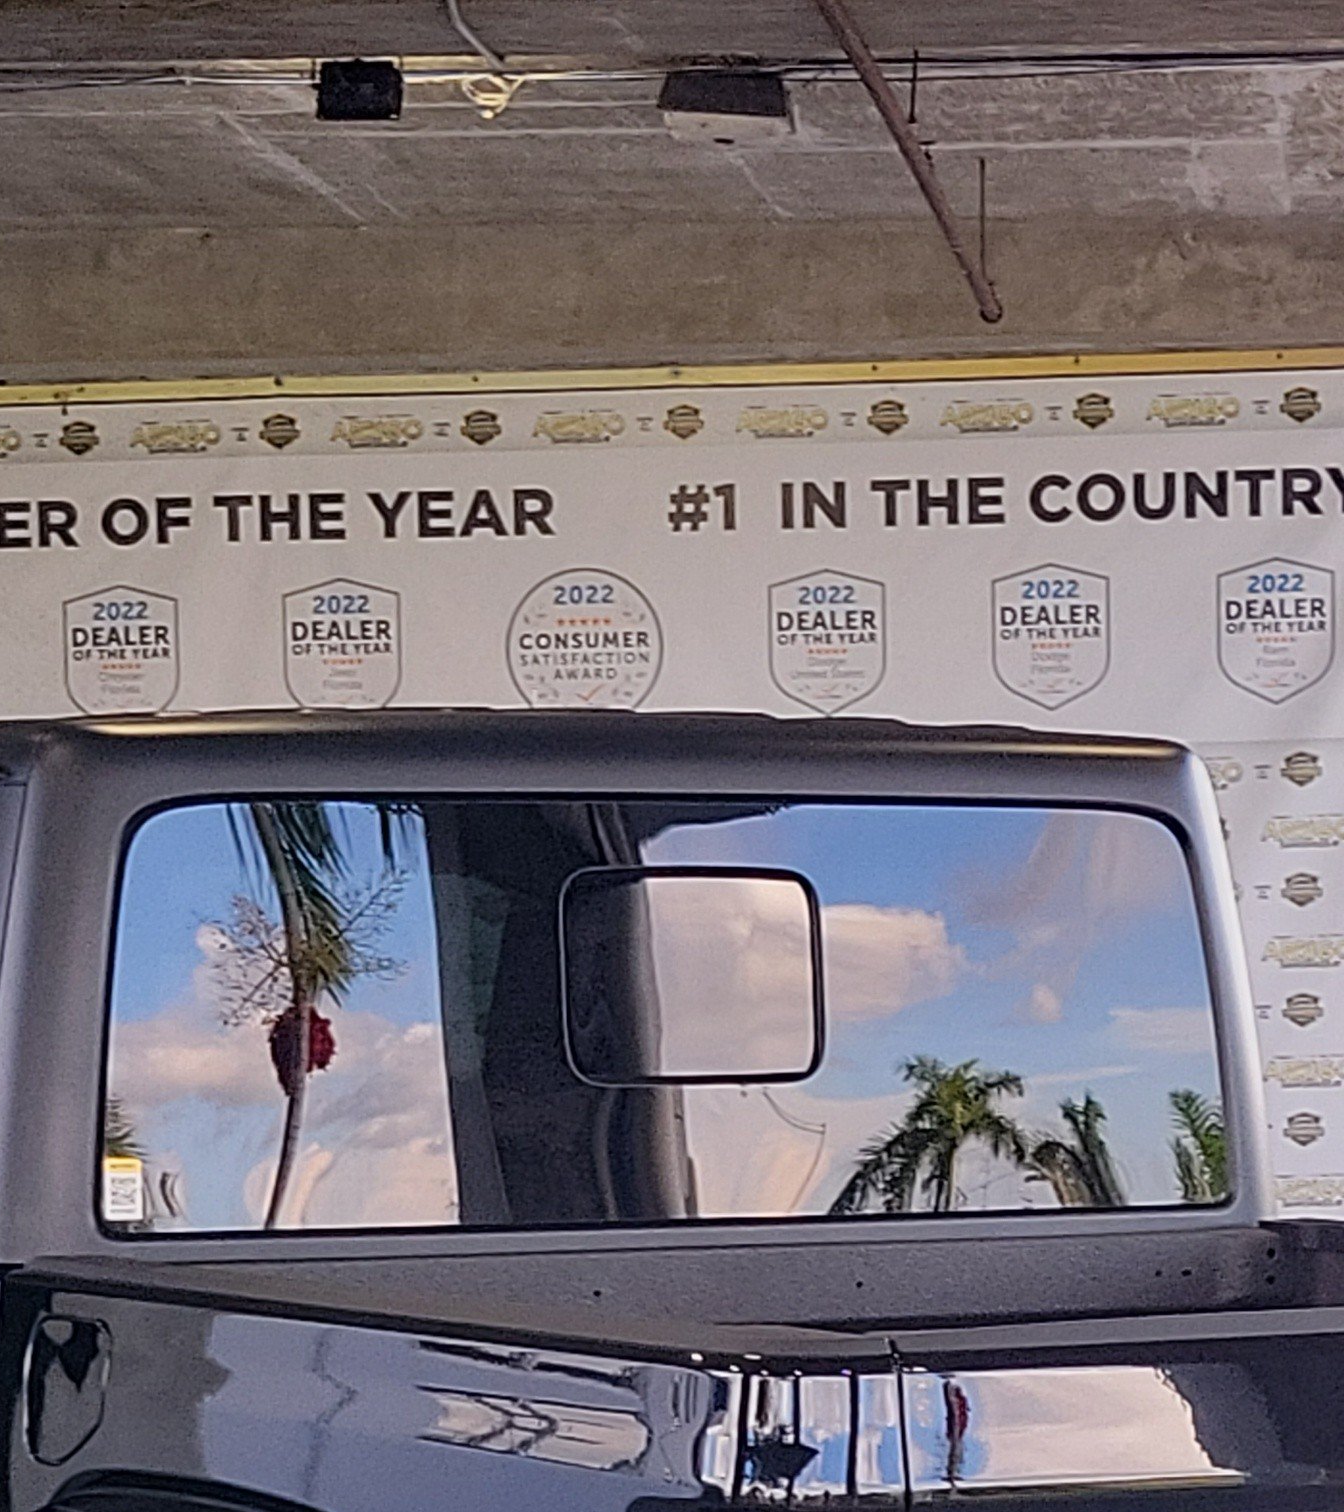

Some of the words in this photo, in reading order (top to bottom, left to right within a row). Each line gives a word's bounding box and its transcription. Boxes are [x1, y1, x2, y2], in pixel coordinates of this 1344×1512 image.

[669, 484, 735, 531] #1
[782, 482, 845, 528] IN
[871, 478, 1004, 526] THE
[102, 497, 191, 545] OF
[214, 493, 345, 541] THE
[368, 489, 553, 538] YEAR
[1021, 580, 1080, 599] 2022
[1247, 573, 1305, 594] 2022
[313, 595, 370, 614] 2022
[553, 584, 614, 605] 2022
[798, 585, 856, 606] 2022
[93, 601, 149, 621] 2022
[1000, 604, 1102, 626] DEALER
[1225, 598, 1327, 620] DEALER
[291, 620, 392, 641] DEALER
[776, 610, 878, 631] DEALER
[1225, 622, 1246, 634] OF
[1251, 622, 1281, 633] THE
[1287, 620, 1327, 632] YEAR
[72, 626, 170, 647] DEALER
[519, 631, 650, 650] CONSUMER
[777, 633, 797, 646] OF
[802, 633, 832, 645] THE
[838, 633, 878, 644] YEAR
[1000, 628, 1020, 640] OF
[1026, 628, 1056, 640] THE
[1061, 627, 1102, 639] YEAR
[72, 649, 91, 661] OF
[98, 649, 126, 660] THE
[132, 648, 170, 659] YEAR
[291, 643, 311, 655] OF
[318, 643, 348, 655] THE
[354, 643, 393, 655] YEAR
[519, 652, 650, 667] SATISFACTION
[553, 668, 618, 681] AWARD
